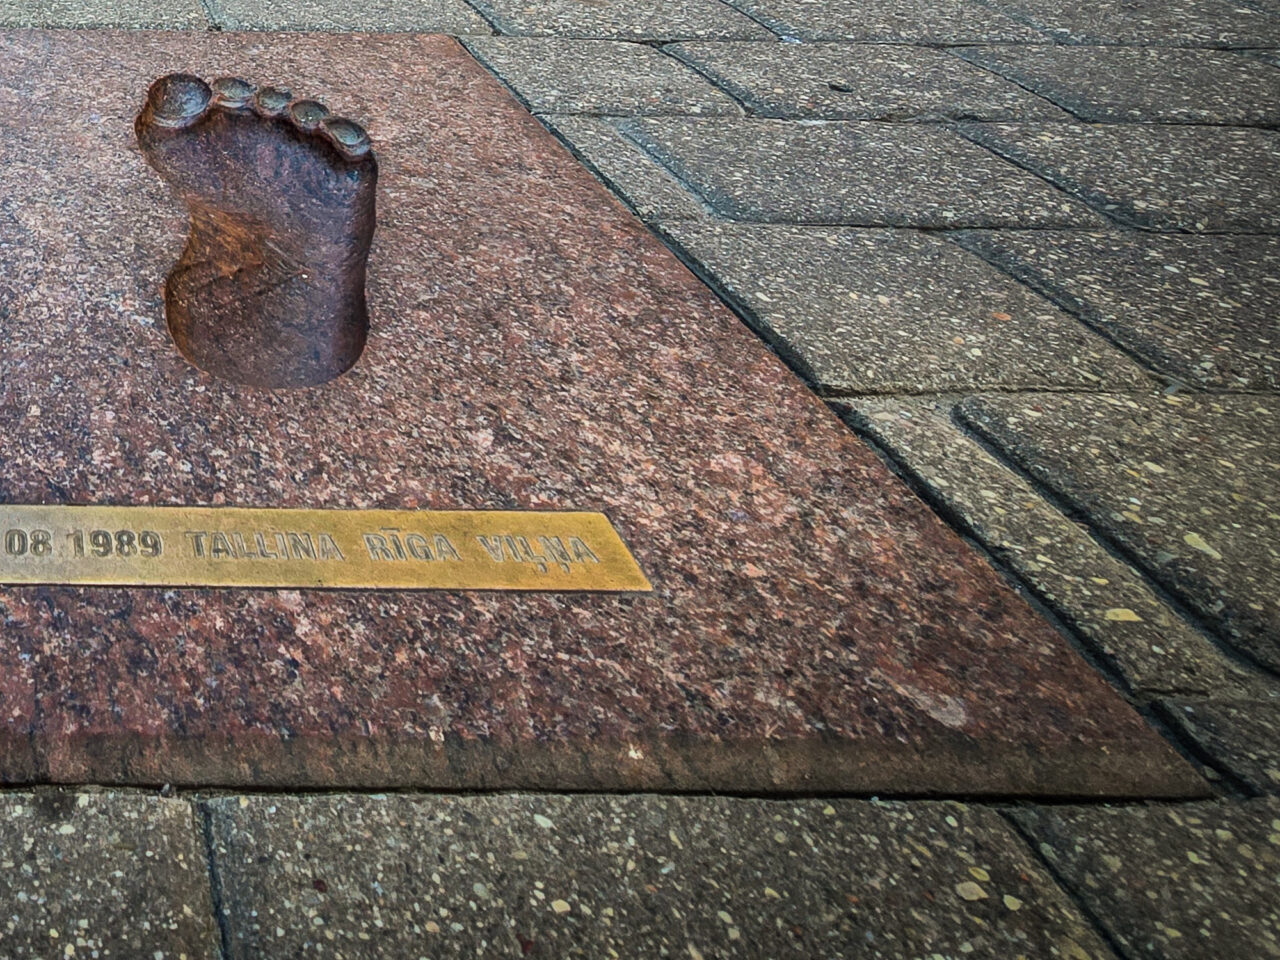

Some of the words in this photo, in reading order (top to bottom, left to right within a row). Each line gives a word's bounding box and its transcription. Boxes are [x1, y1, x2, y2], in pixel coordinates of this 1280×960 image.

[4, 528, 53, 557] 08
[66, 529, 163, 558] 1989
[184, 530, 346, 561] TALLINA
[362, 526, 464, 562] RĪGA
